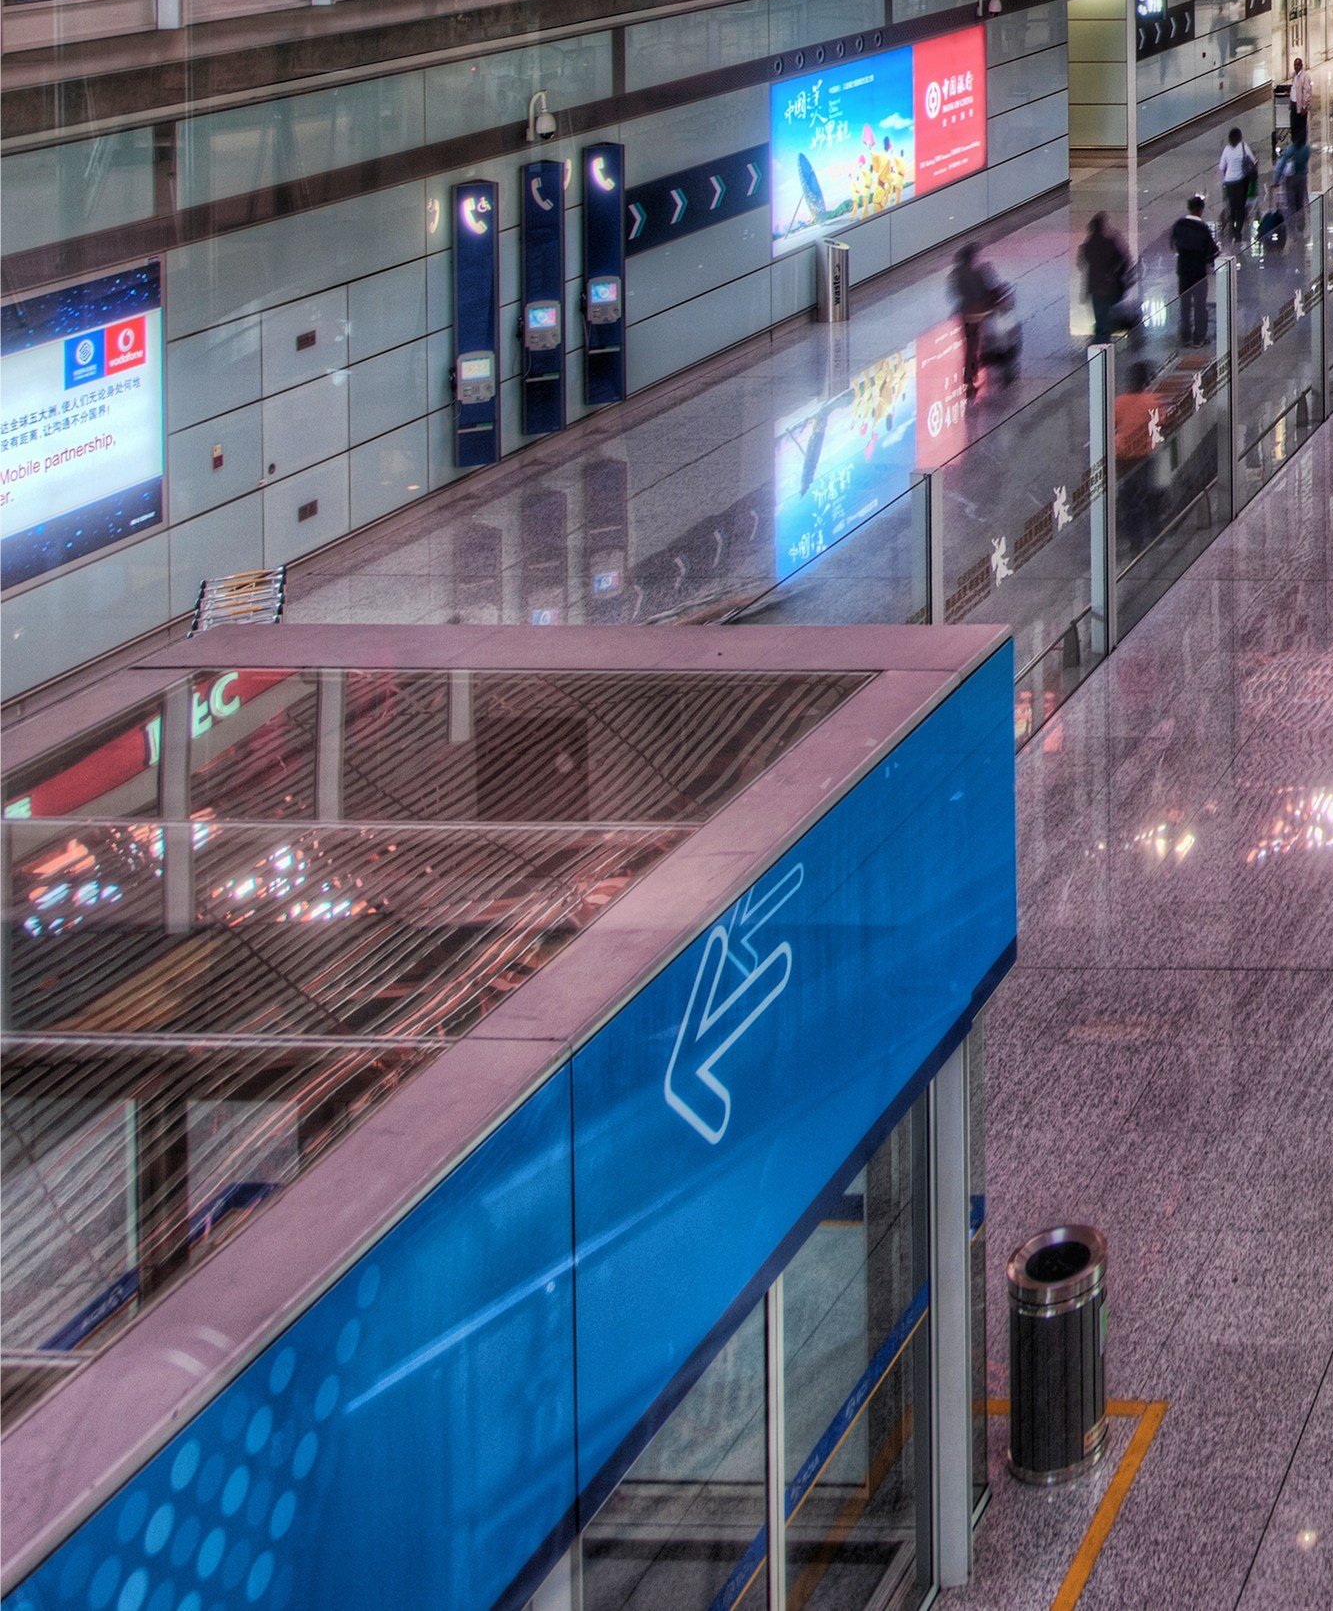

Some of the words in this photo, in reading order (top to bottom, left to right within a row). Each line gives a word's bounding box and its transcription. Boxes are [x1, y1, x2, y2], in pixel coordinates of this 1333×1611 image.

[942, 70, 974, 101] 中国银行
[942, 103, 954, 114] BANK
[960, 96, 974, 108] CHINA
[832, 274, 841, 305] waste
[109, 350, 144, 368] vodafone
[0, 459, 41, 486] Mobile
[44, 432, 116, 473] partnership,
